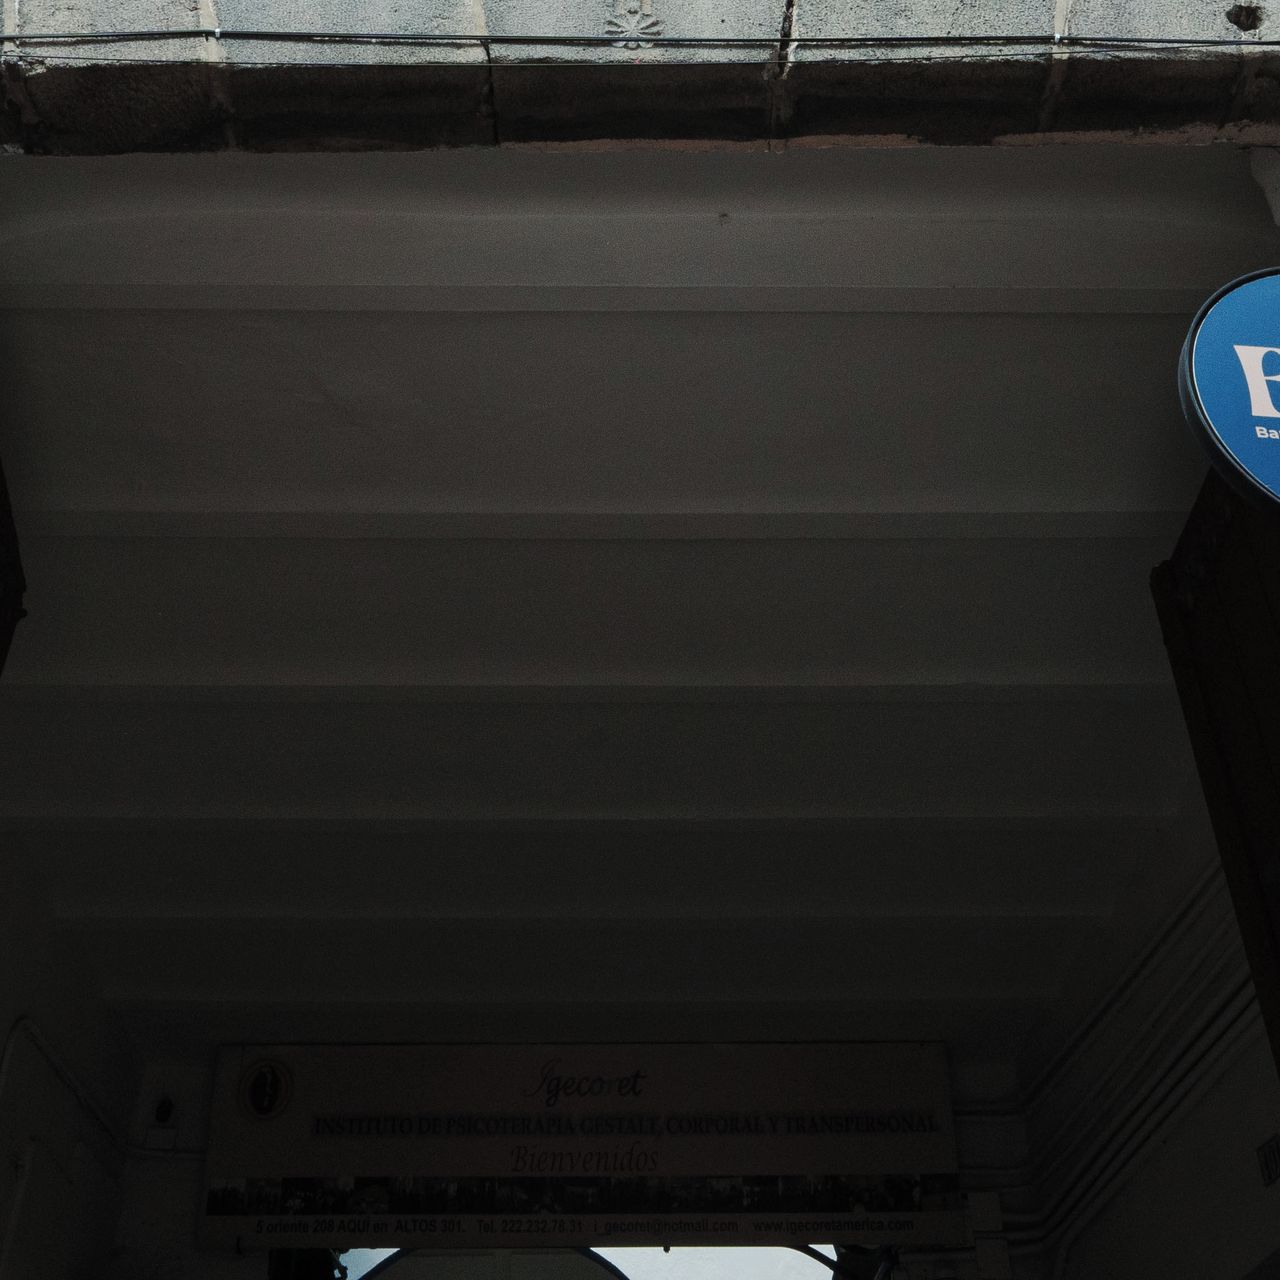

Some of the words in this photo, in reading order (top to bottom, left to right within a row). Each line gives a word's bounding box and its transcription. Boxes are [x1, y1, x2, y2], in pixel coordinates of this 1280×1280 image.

[314, 1116, 413, 1136] INSTITUTO
[417, 1116, 443, 1136] DE
[446, 1116, 575, 1136] PSICOTERAPIA
[665, 1115, 762, 1135] CORPORAL
[765, 1115, 780, 1134] Y
[783, 1114, 940, 1134] TRANSPERSONAL
[510, 1140, 659, 1173] Bienvenidos
[312, 1219, 335, 1233] 208
[393, 1219, 437, 1233] ALTOS
